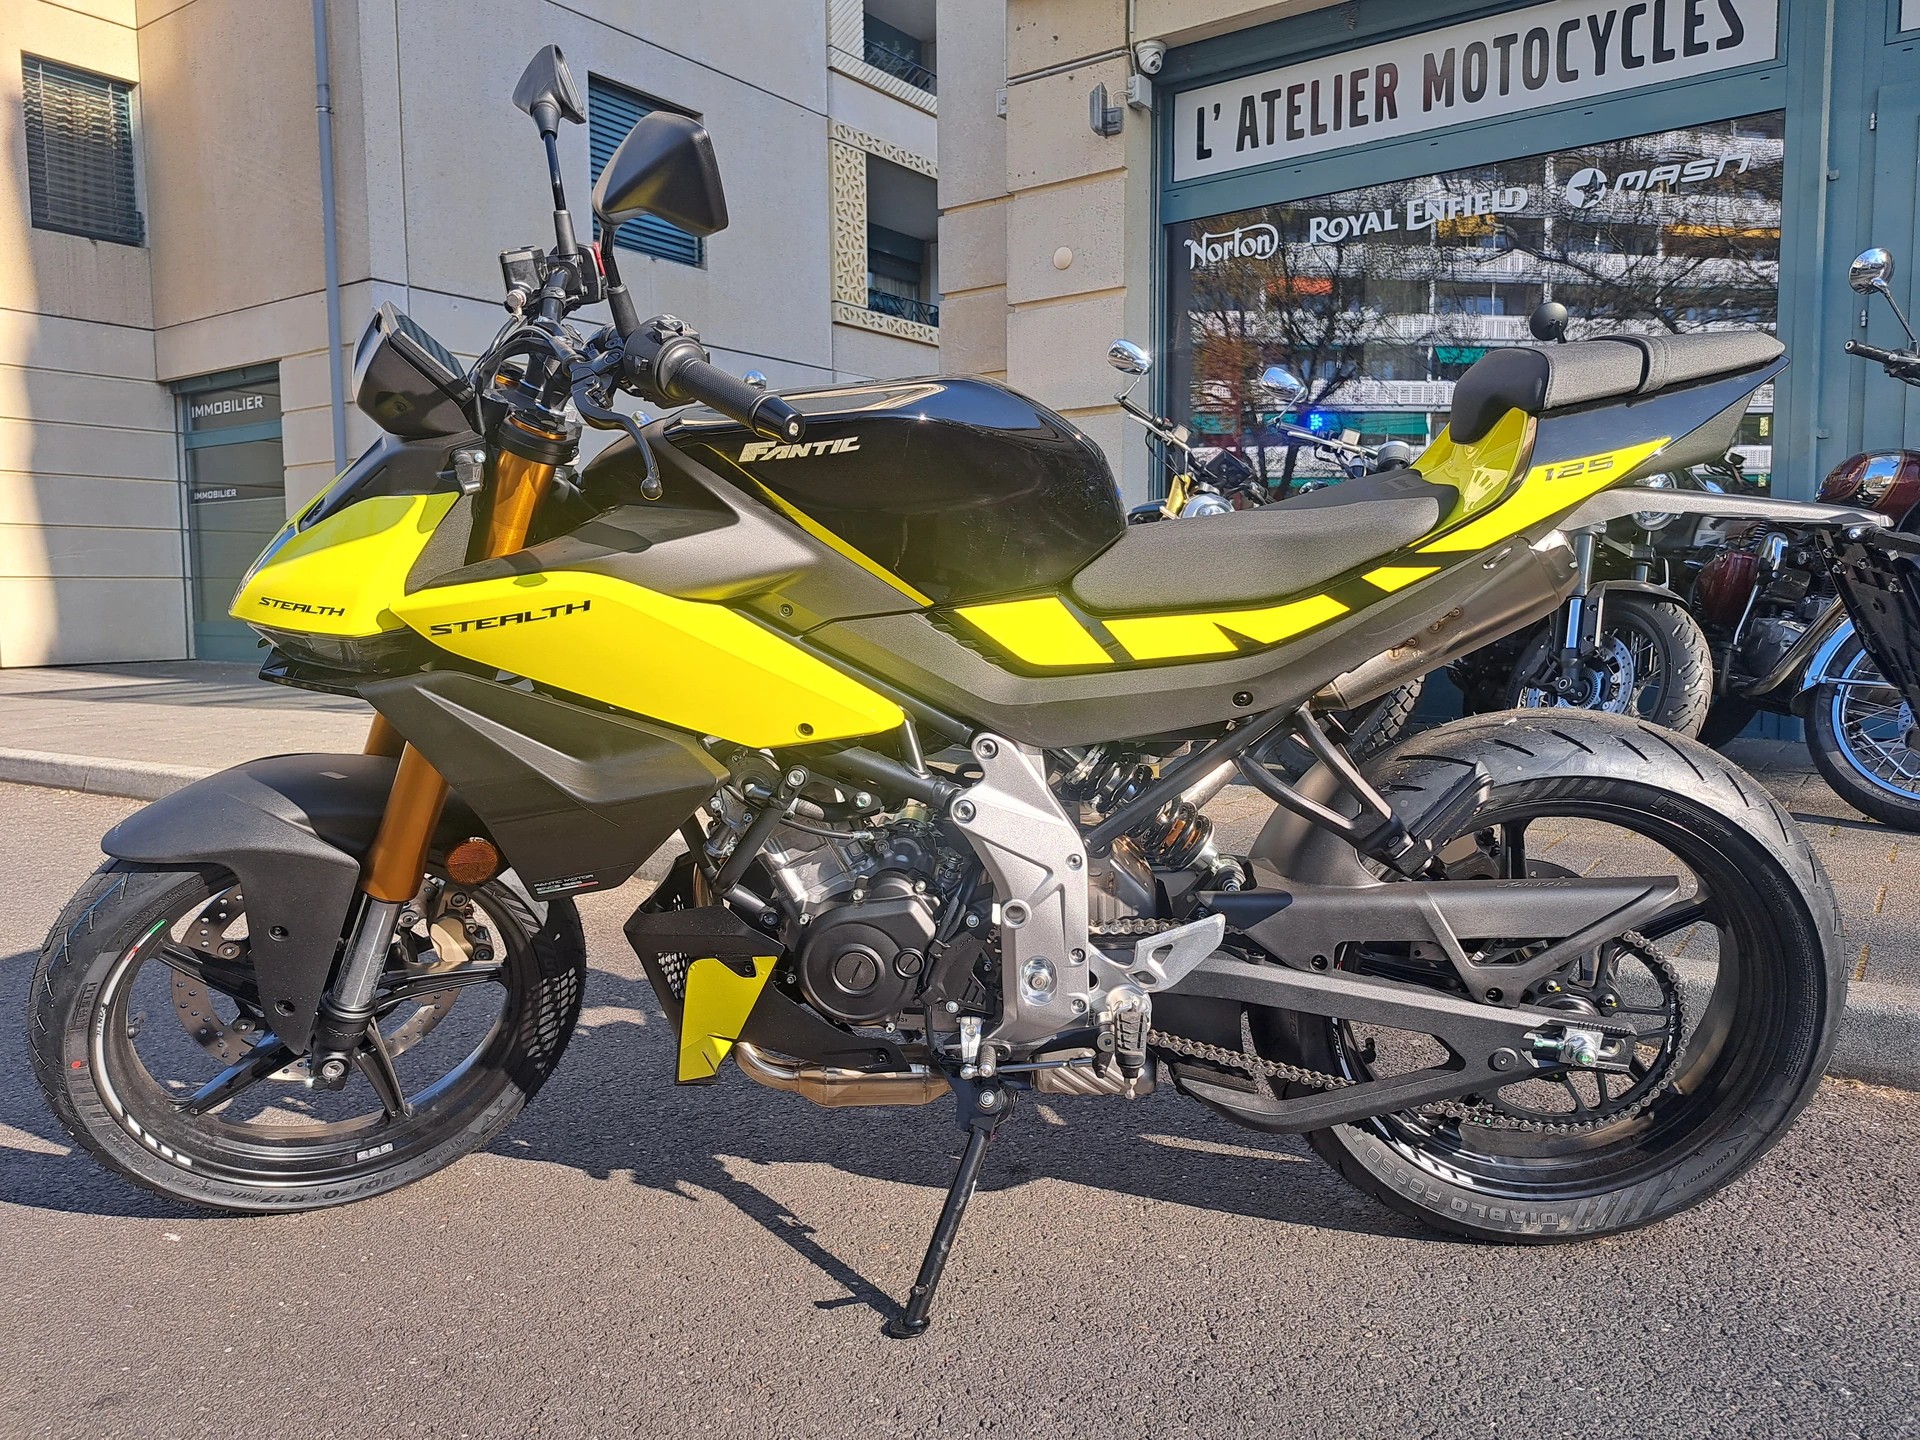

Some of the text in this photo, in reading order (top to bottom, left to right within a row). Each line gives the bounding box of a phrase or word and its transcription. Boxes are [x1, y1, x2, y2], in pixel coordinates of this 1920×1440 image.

[1236, 62, 1398, 152] ATELIER
[1422, 0, 1745, 113] MOTOCYCLES
[1309, 187, 1529, 244] ROYAL ENFIELD
[1183, 223, 1279, 270] Norton
[191, 395, 264, 418] IMMOBILIER
[738, 436, 861, 463] FANTIC
[1545, 455, 1614, 482] 125
[194, 489, 237, 500] IMMOBILIER
[258, 596, 346, 617] STEALTH
[428, 600, 592, 637] STEALTH
[1366, 1145, 1442, 1204] ROSSO
[1682, 1150, 1732, 1188] ROTATION
[1450, 1196, 1560, 1228] DIABLO
